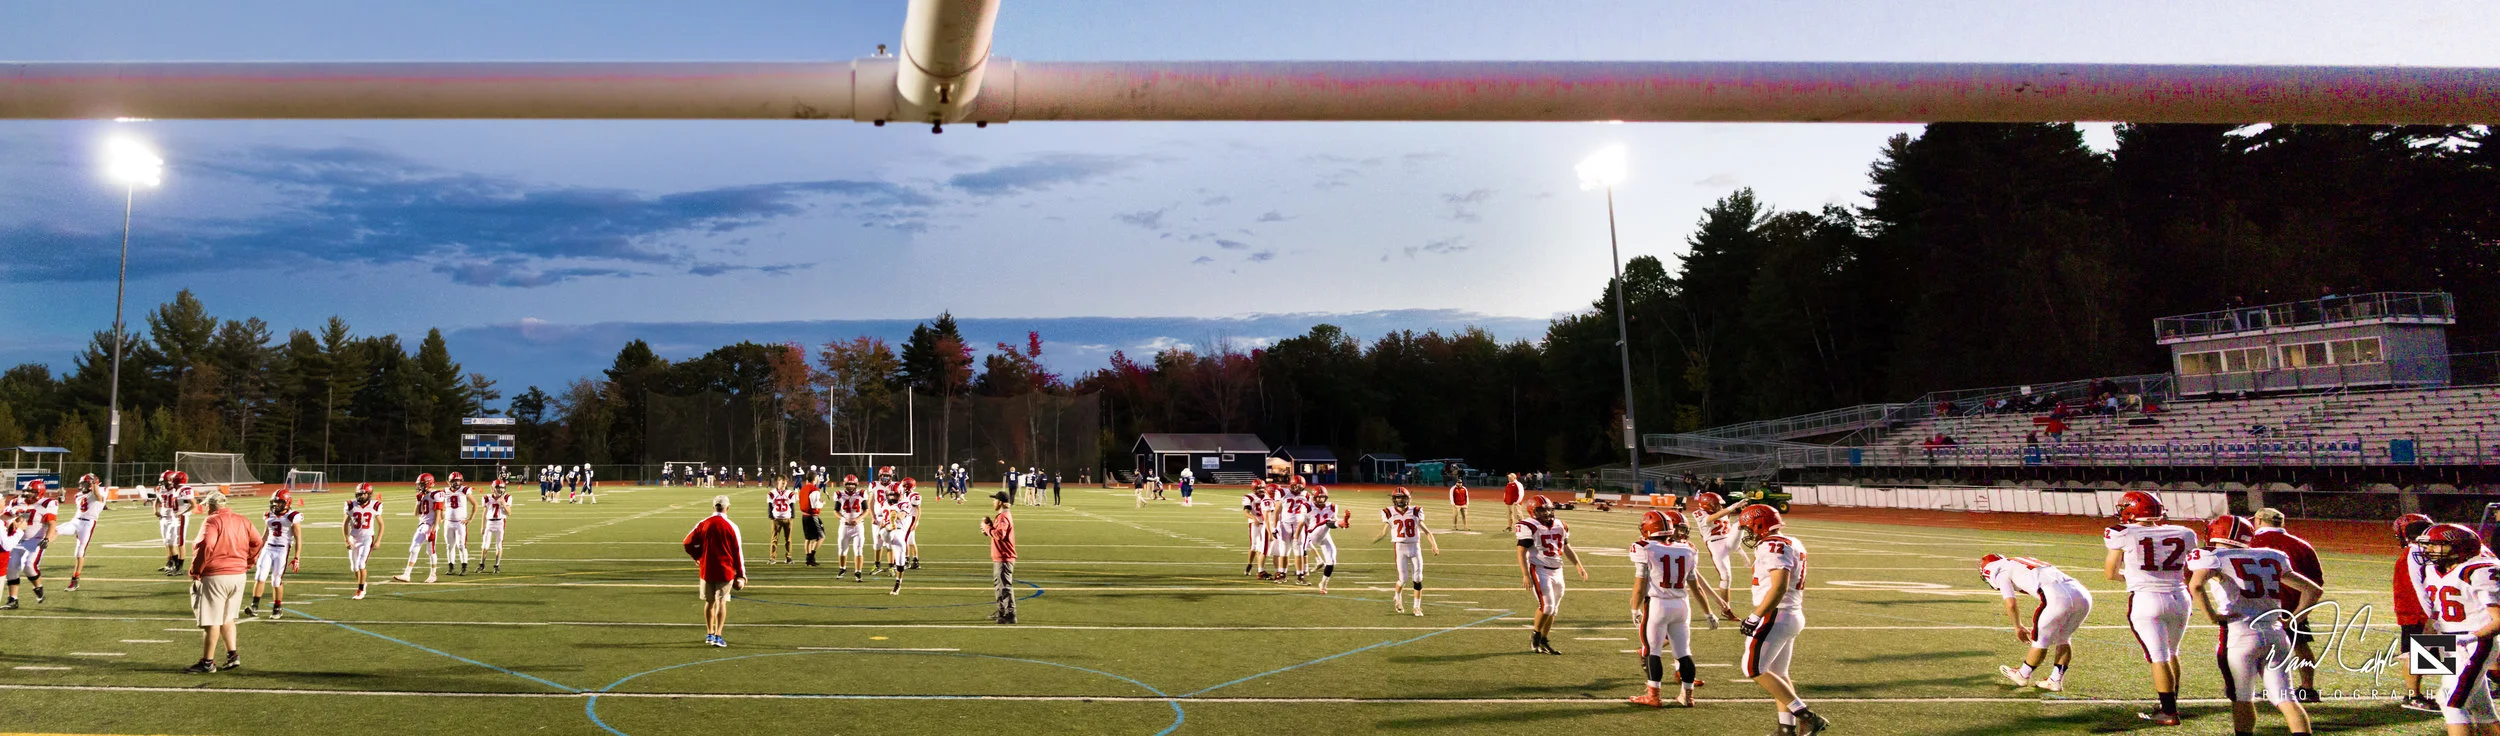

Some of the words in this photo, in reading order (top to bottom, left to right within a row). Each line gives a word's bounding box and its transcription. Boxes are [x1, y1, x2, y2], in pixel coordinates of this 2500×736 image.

[492, 504, 499, 518] 7
[843, 500, 860, 512] 44
[353, 512, 372, 529] 33
[1394, 519, 1415, 538] 28
[271, 522, 282, 537] 3
[1769, 543, 1785, 554] 72
[2139, 537, 2185, 571] 12
[1660, 554, 1685, 589] 11
[2230, 558, 2282, 599] 53
